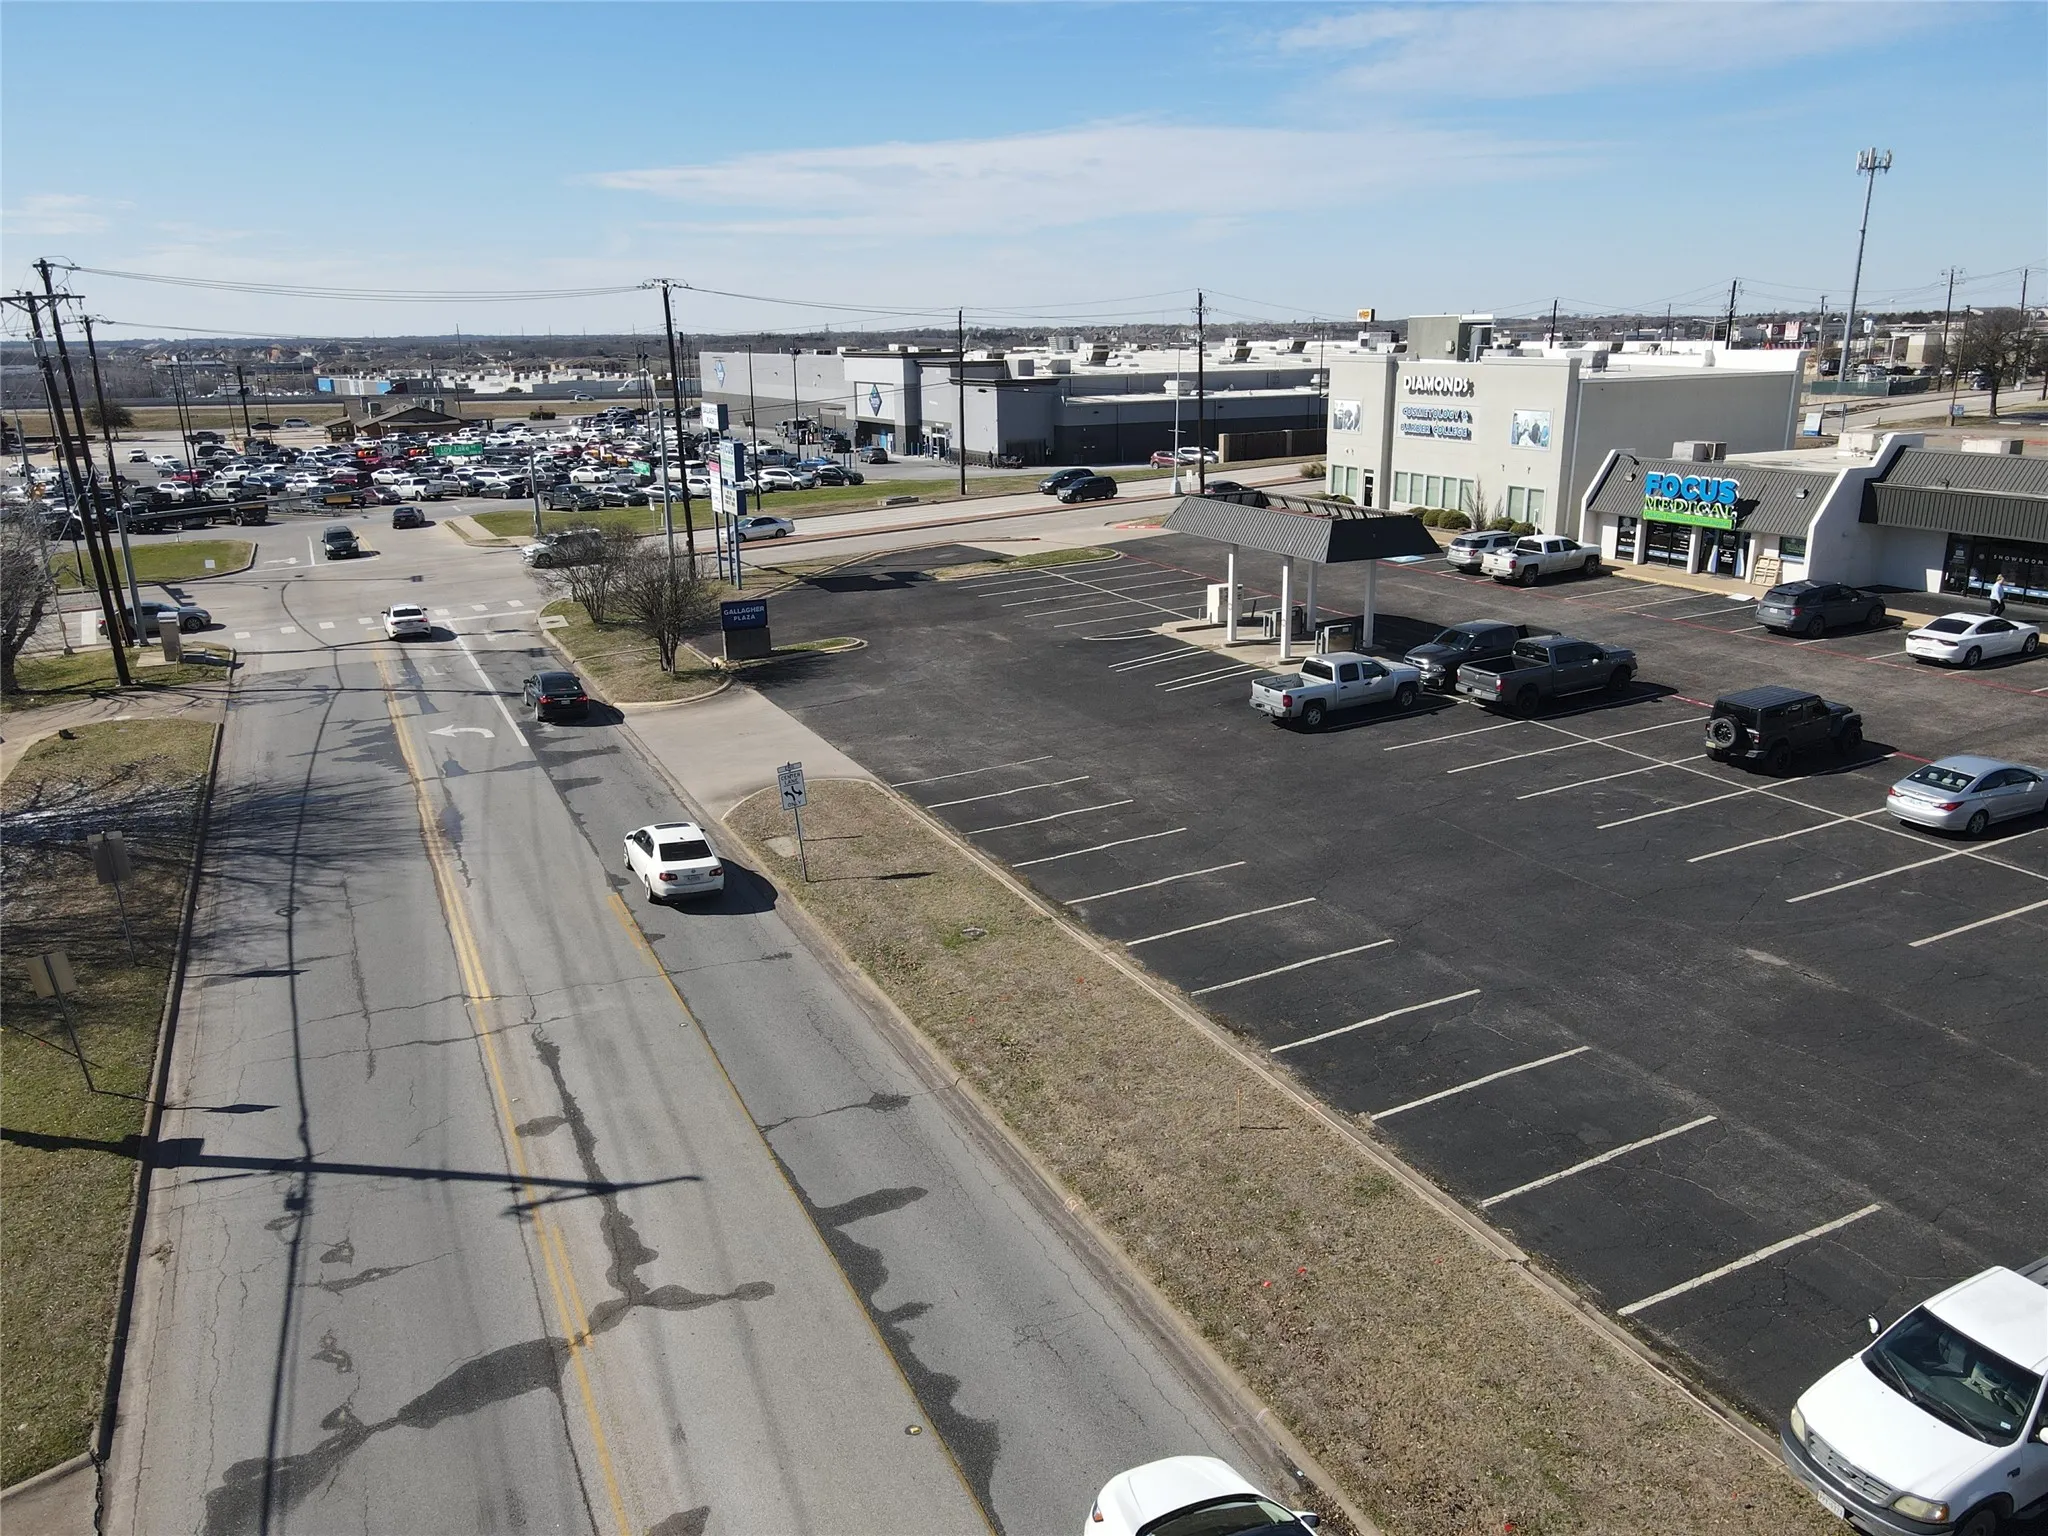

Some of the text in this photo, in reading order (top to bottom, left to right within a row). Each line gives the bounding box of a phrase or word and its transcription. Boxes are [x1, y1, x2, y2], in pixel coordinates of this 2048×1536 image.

[1403, 375, 1468, 392] DIAMONDS
[1402, 406, 1459, 420] COSMETOLOGY
[1401, 423, 1468, 437] BARBER COLLEGE
[454, 445, 469, 453] Lake
[1645, 471, 1739, 504] FOCUS
[1645, 496, 1737, 518] MEDICAL
[1993, 554, 2044, 566] SHOWROOM
[723, 605, 765, 616] GALLAGHER
[733, 614, 756, 622] PLAZA
[781, 773, 800, 781] CENTER
